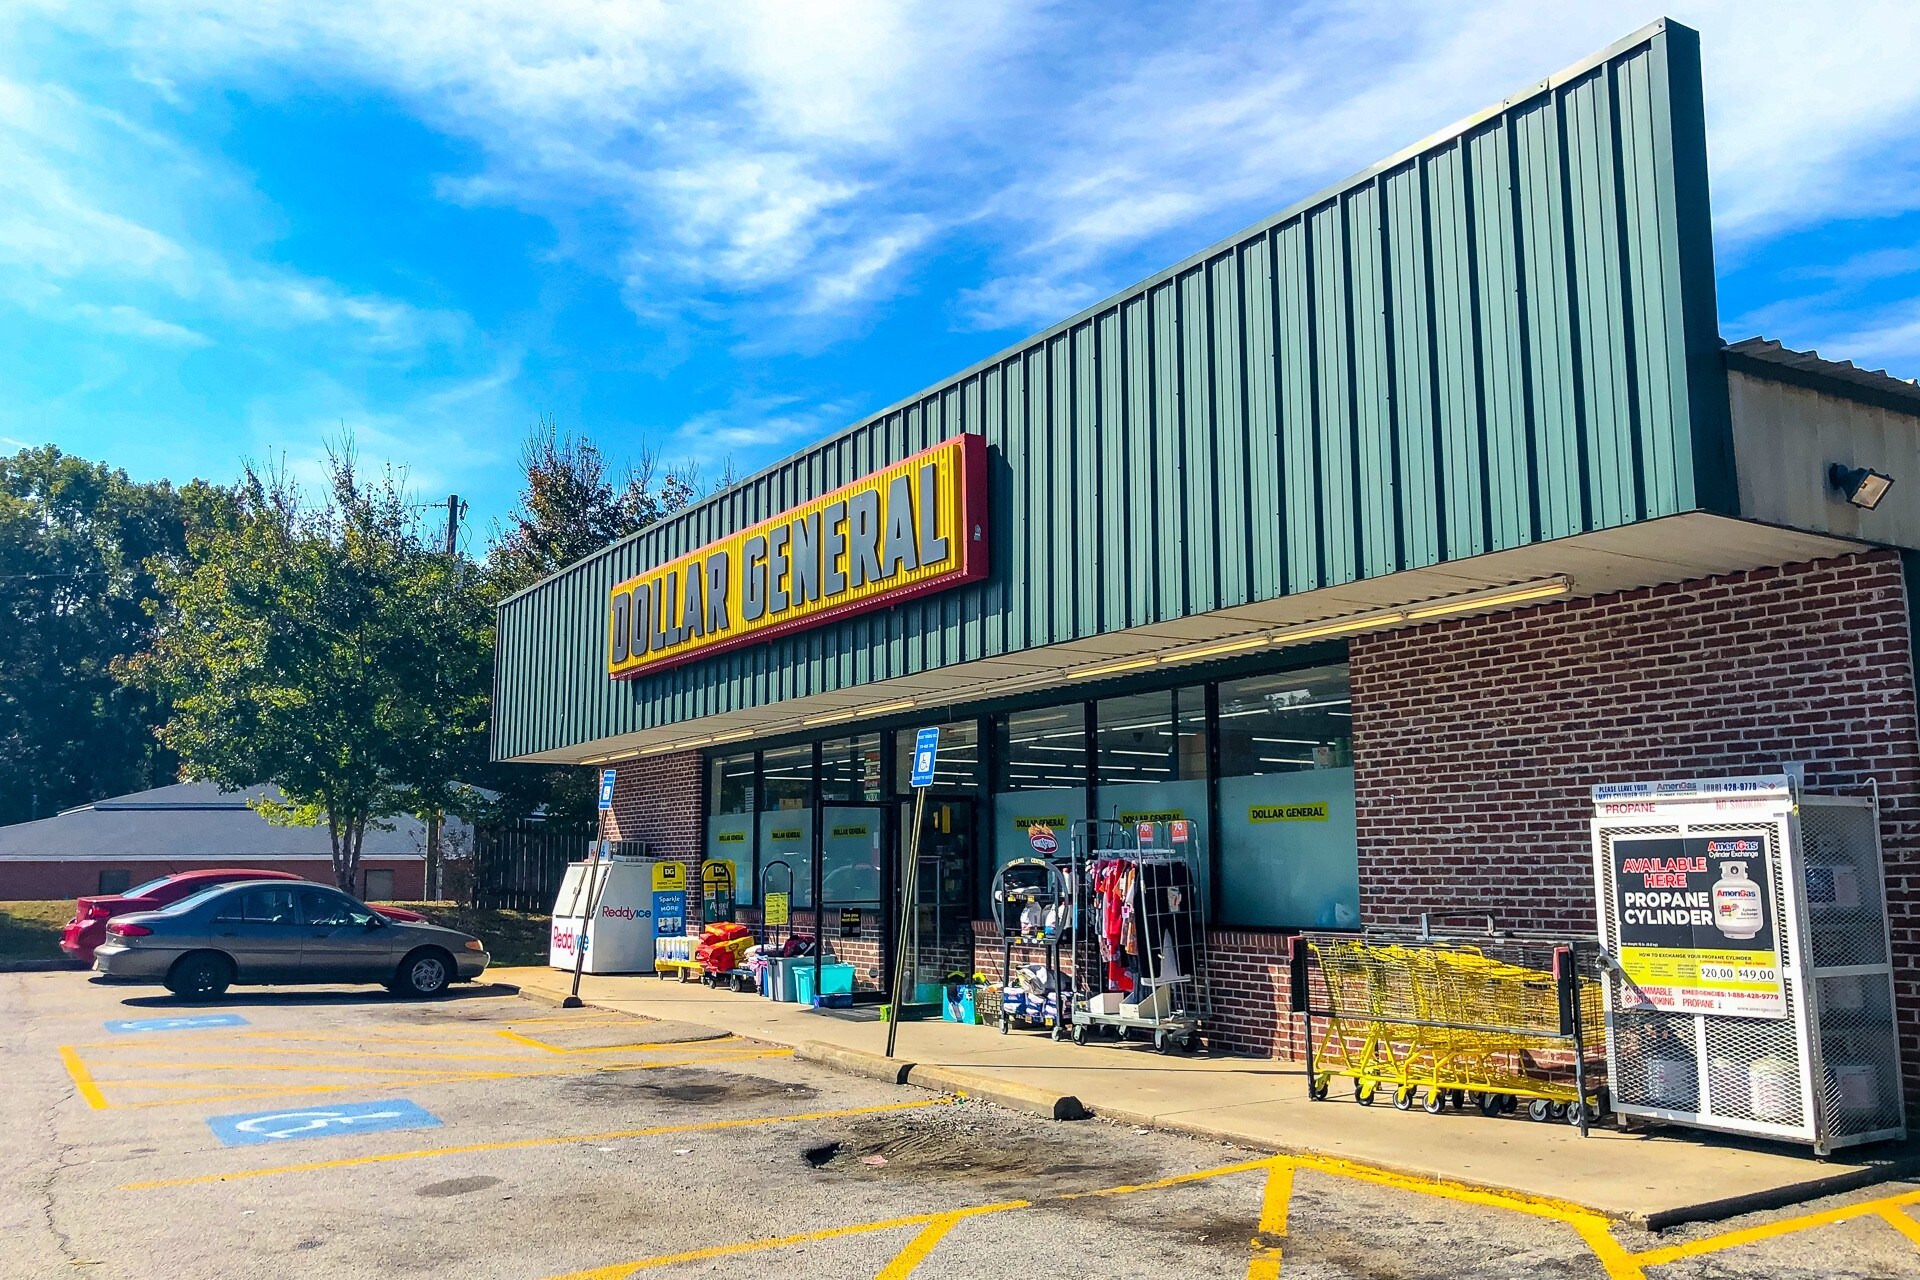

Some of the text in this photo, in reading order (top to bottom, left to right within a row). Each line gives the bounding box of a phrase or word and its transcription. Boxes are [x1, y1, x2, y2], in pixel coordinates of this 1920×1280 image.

[611, 462, 949, 664] DOLLAR GENERAL
[1252, 807, 1324, 818] DOLLAR GENERAL
[1606, 803, 1656, 814] PROPANE
[1707, 840, 1759, 851] AmeriGas
[1623, 857, 1707, 873] AVAILABLE
[1644, 873, 1687, 888] HERE
[1624, 891, 1710, 908] PROPANE
[1624, 909, 1714, 926] CYLINDER
[1701, 968, 1733, 979] $20.00
[1739, 970, 1774, 980] $49.00
[1682, 989, 1726, 997] EMERGENCIES:
[1683, 998, 1714, 1008] PROPANE
